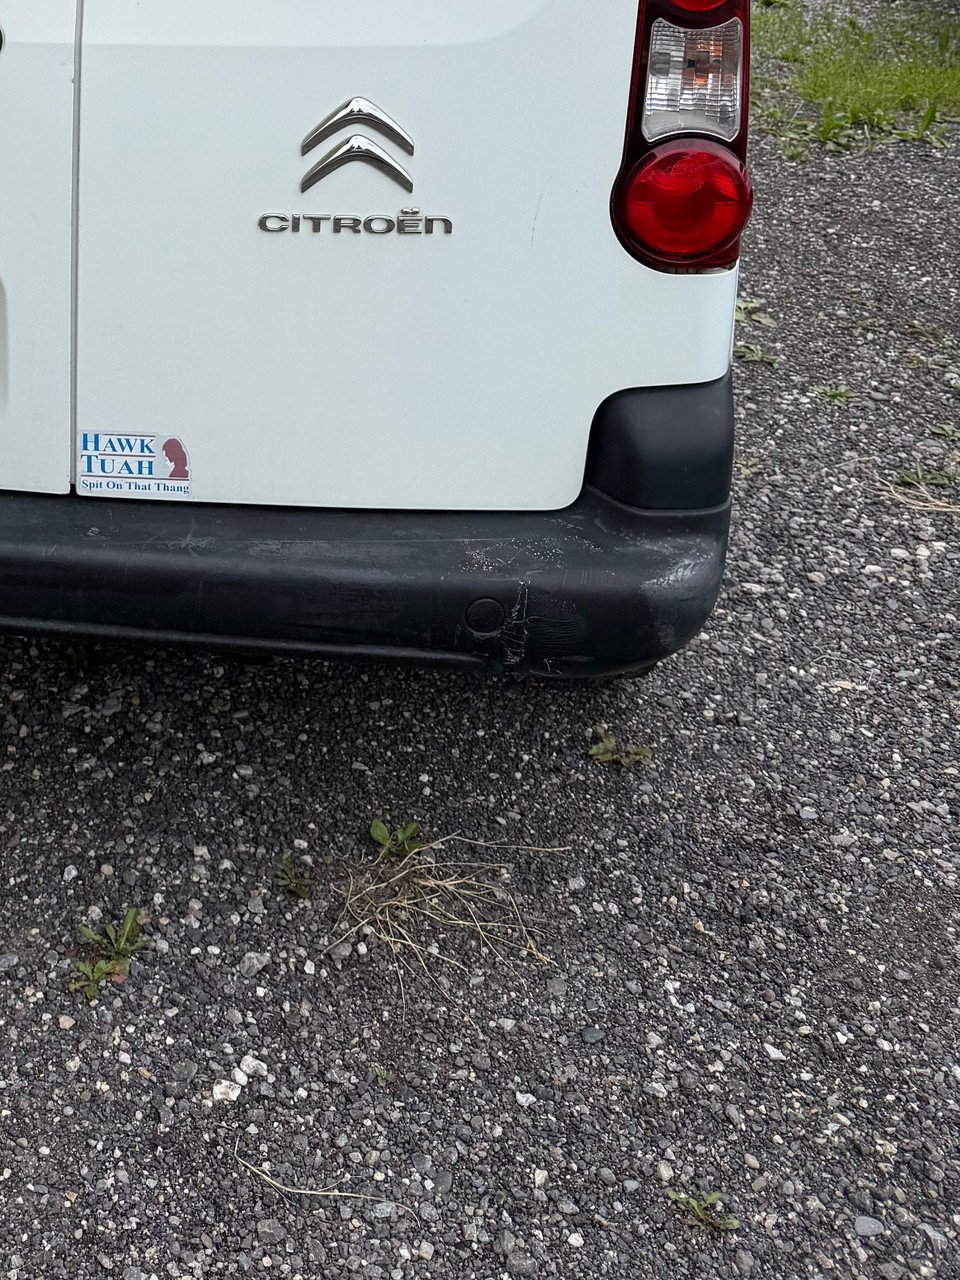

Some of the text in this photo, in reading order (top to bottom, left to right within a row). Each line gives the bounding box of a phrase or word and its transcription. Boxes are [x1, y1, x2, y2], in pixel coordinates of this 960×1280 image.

[81, 433, 156, 454] HAWK
[80, 454, 154, 476] TUAH
[81, 479, 190, 494] Spit On That Thang
